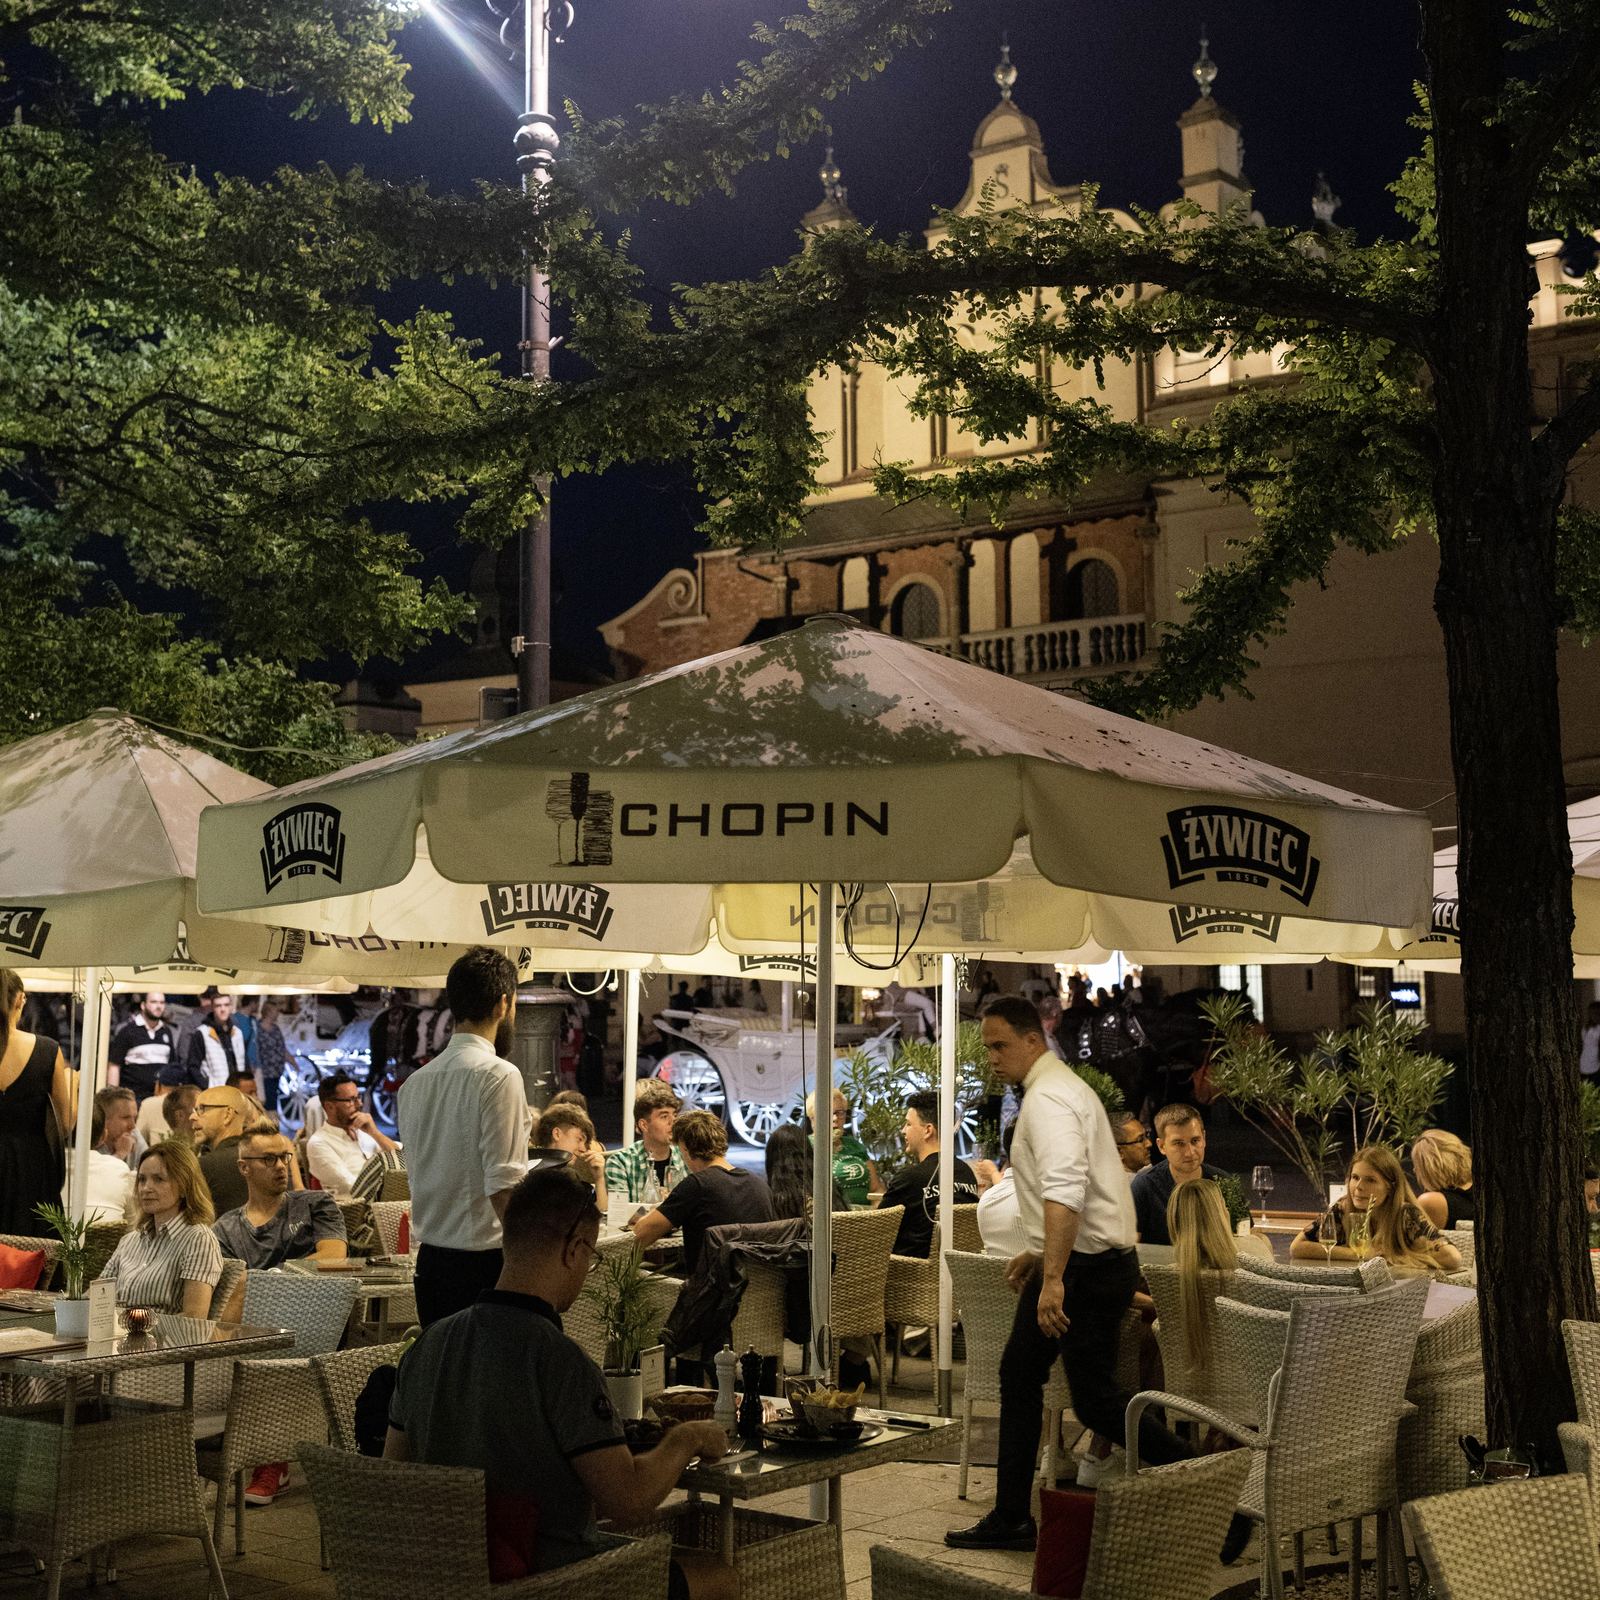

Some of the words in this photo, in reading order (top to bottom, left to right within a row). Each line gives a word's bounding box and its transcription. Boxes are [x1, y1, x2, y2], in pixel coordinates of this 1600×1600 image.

[269, 811, 336, 866] ŻYWIEC
[620, 802, 889, 837] CHOPIN
[1181, 810, 1300, 875] ŻYWIEC
[1227, 872, 1259, 884] 1856
